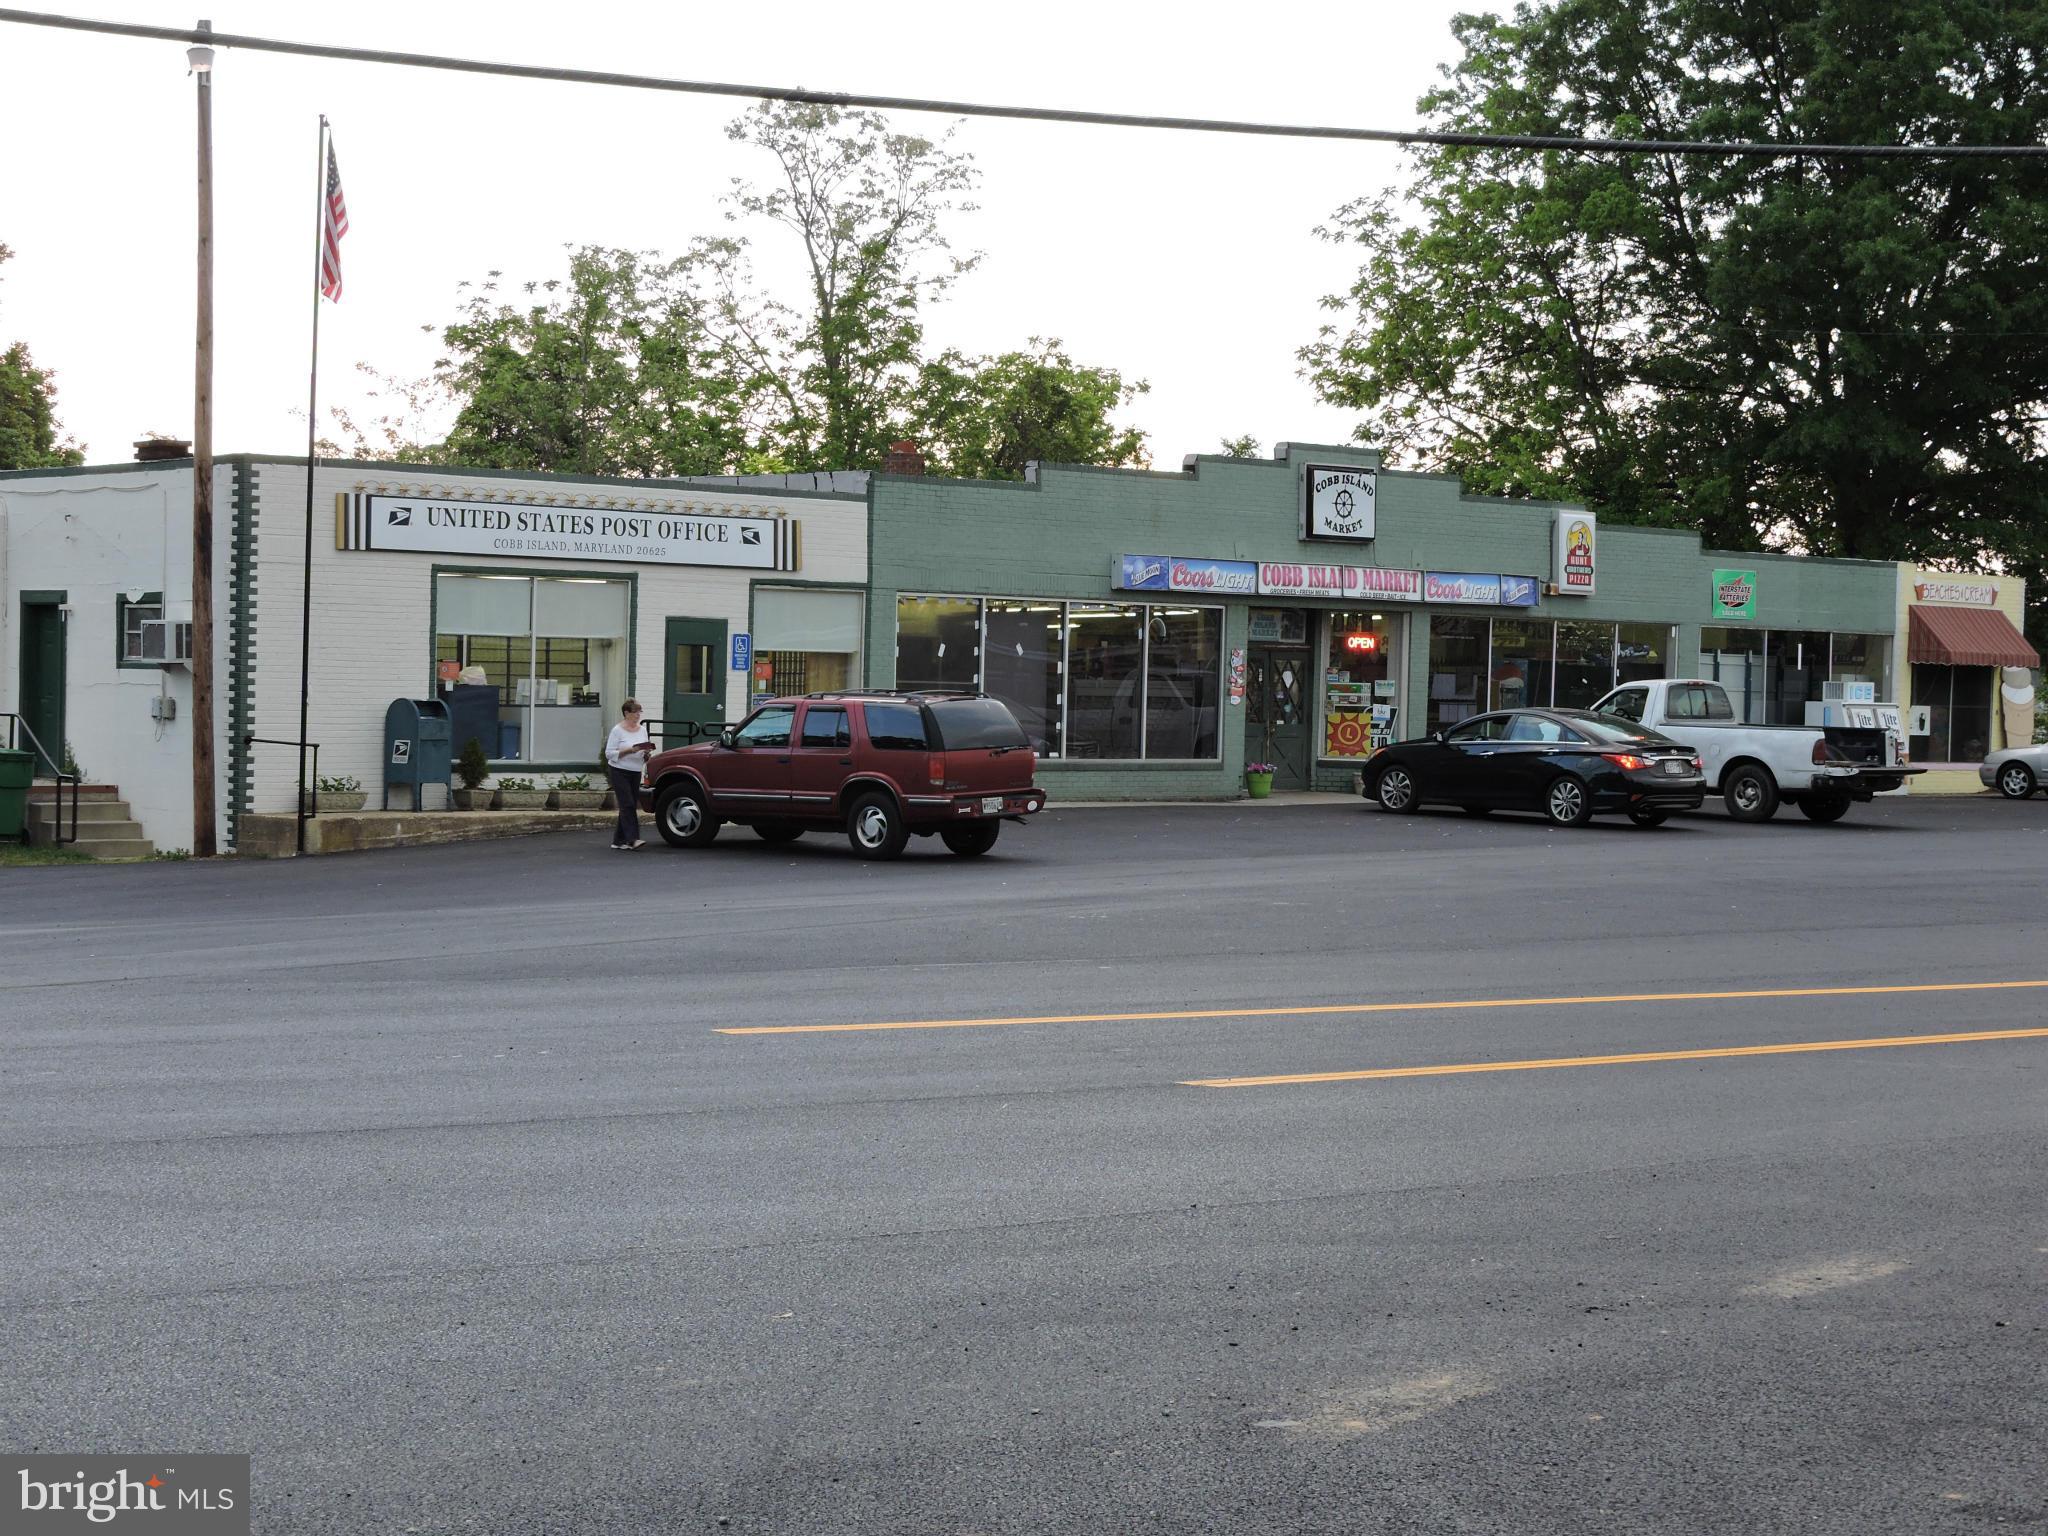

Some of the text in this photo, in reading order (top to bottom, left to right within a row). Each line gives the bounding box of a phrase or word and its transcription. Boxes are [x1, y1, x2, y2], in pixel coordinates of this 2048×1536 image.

[1316, 474, 1374, 496] COBB ISLAND
[427, 507, 729, 543] UNITED STATES POST OFFICE
[1324, 517, 1363, 534] MARKET
[494, 538, 667, 556] COBB ISLAND, MARYLAND 20625
[1571, 556, 1587, 565] HUNT
[1172, 562, 1254, 589] Coors LIGHT
[1262, 563, 1418, 593] COBB ISLAND MARKET
[1569, 574, 1589, 584] PIZZA
[1426, 576, 1497, 600] Coors LIGHT
[1719, 585, 1752, 594] INTERSTATE
[1923, 584, 1960, 599] BEACHES
[1965, 586, 1991, 601] CREAM
[1719, 593, 1749, 602] BATTERIES
[1348, 637, 1375, 648] OPEN
[1850, 685, 1872, 699] ICE
